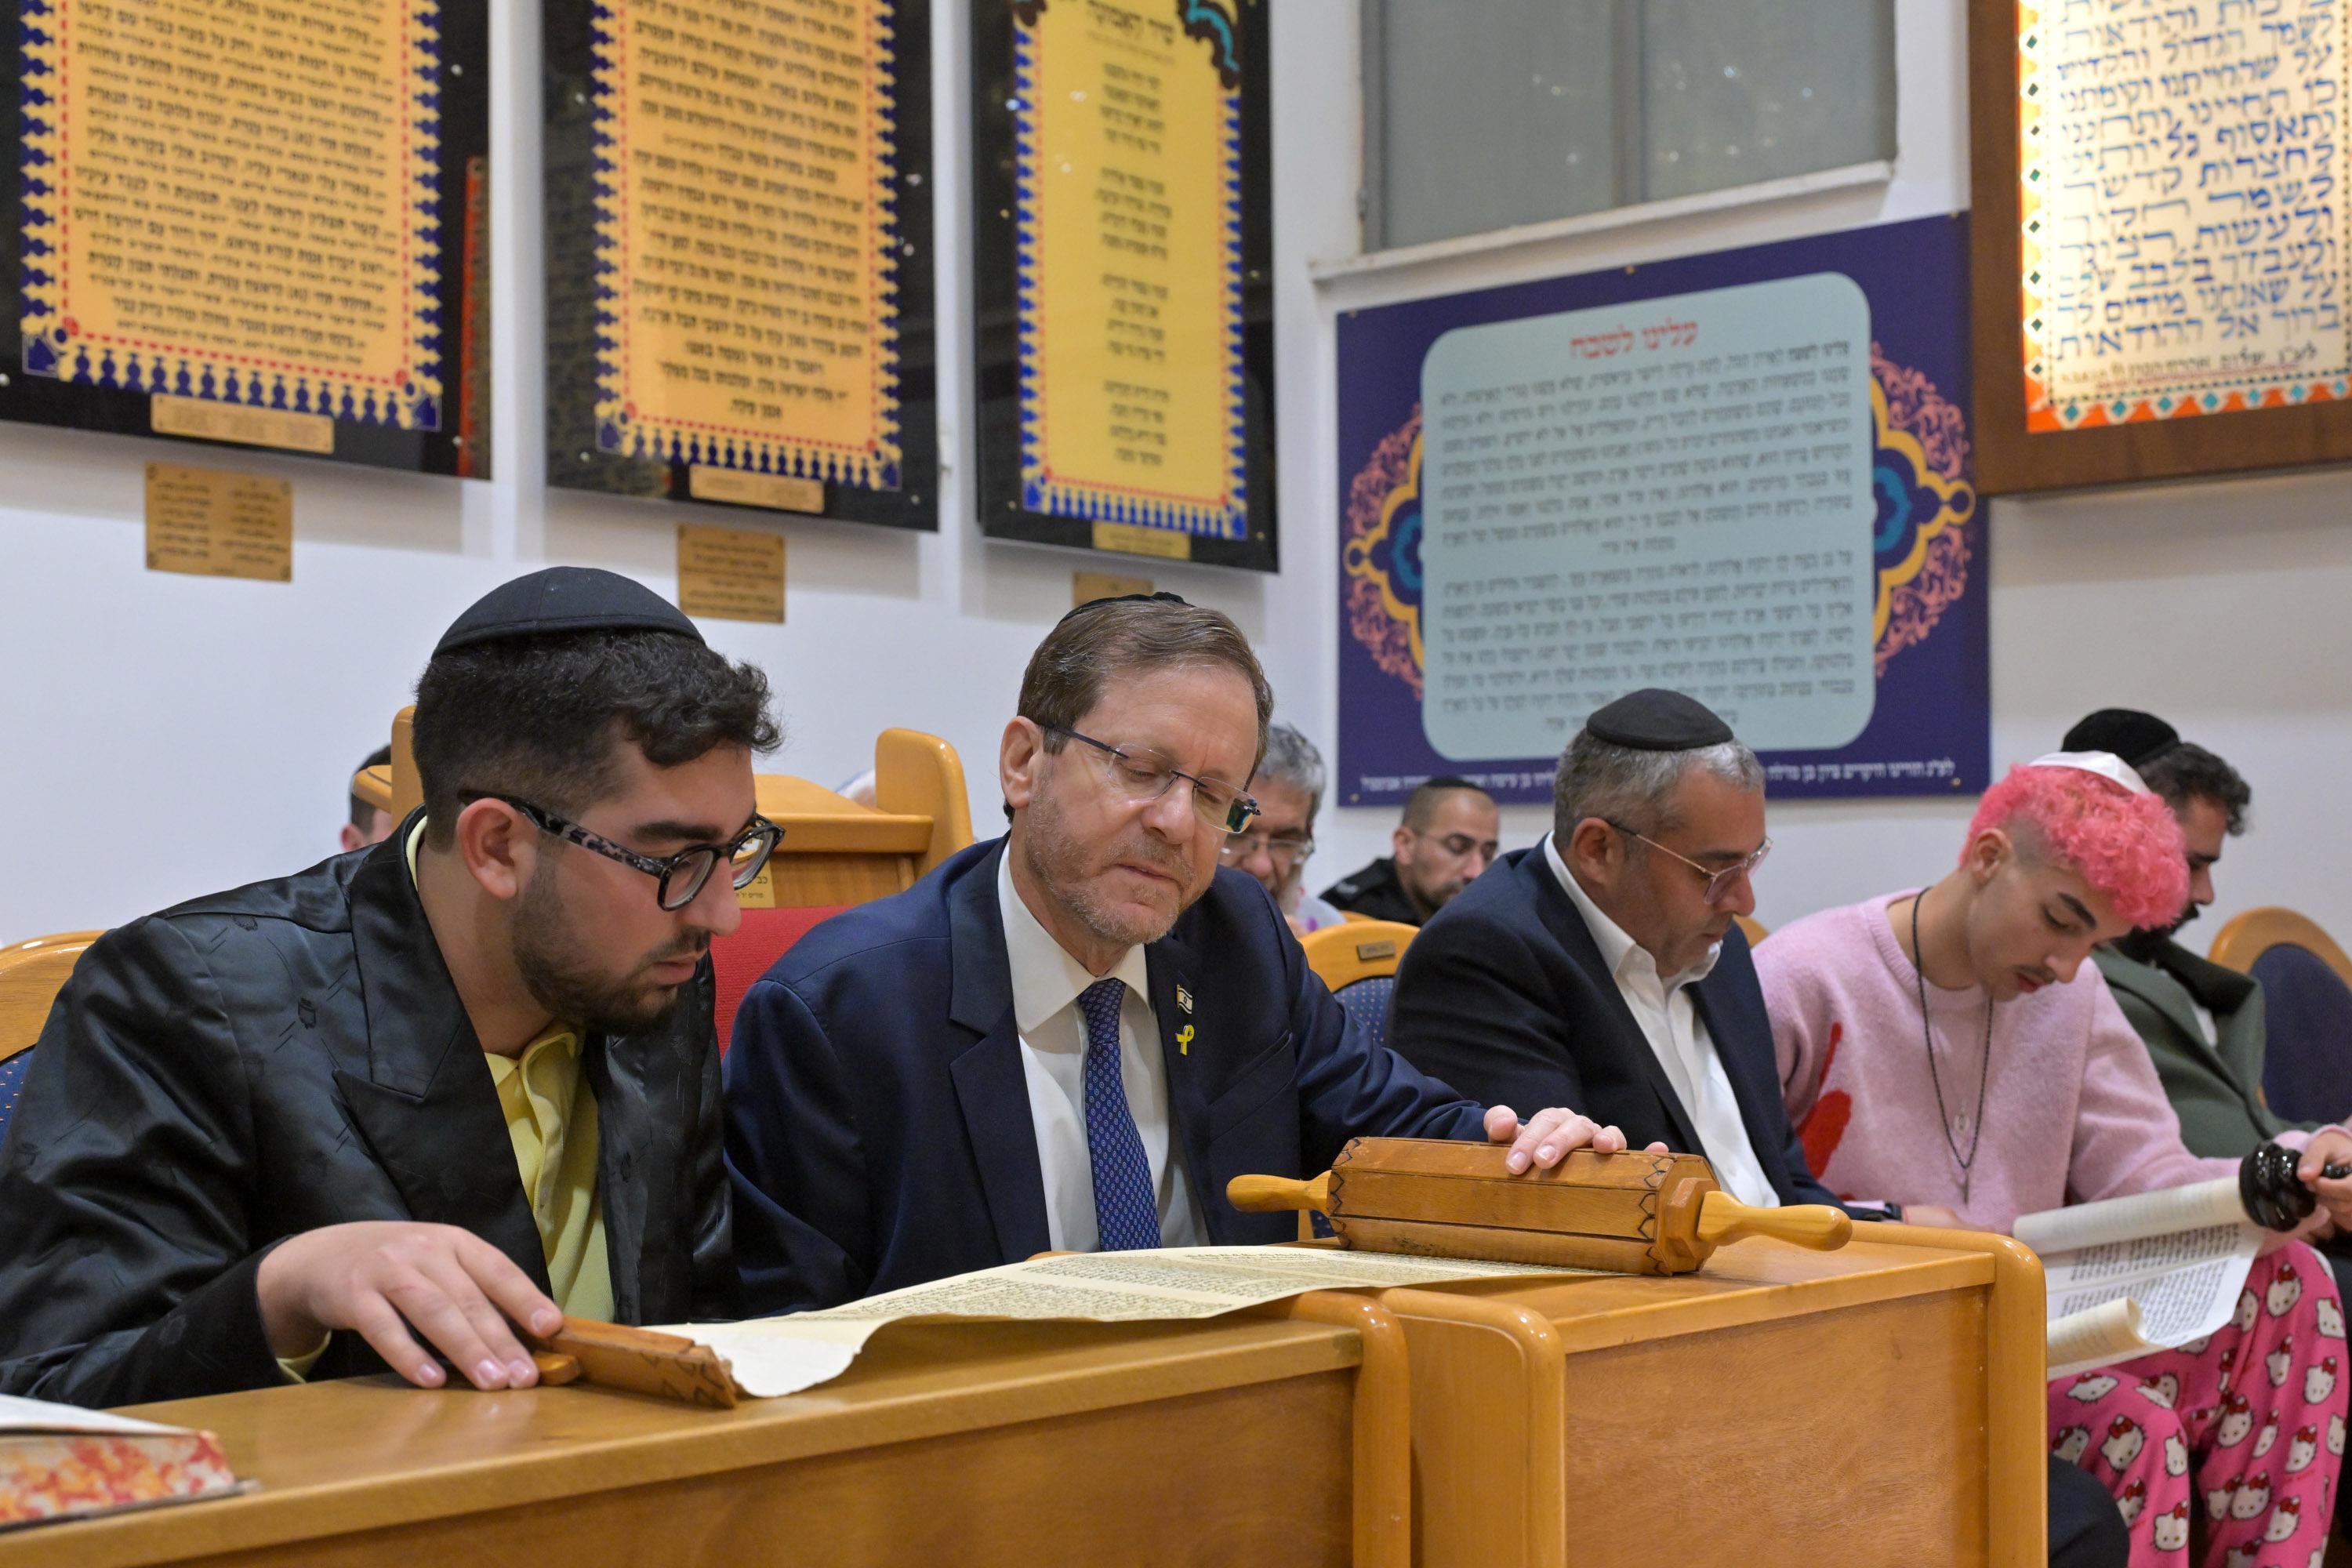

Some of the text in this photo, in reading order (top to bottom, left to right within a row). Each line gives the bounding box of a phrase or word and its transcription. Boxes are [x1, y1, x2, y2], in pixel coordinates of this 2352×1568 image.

[2292, 42, 2333, 75] על
[2303, 78, 2338, 110] כן
[2301, 263, 2339, 299] על
[1570, 317, 1700, 359] עלינו לשבח
[2215, 309, 2260, 339] אל
[2270, 303, 2341, 342] ברוך
